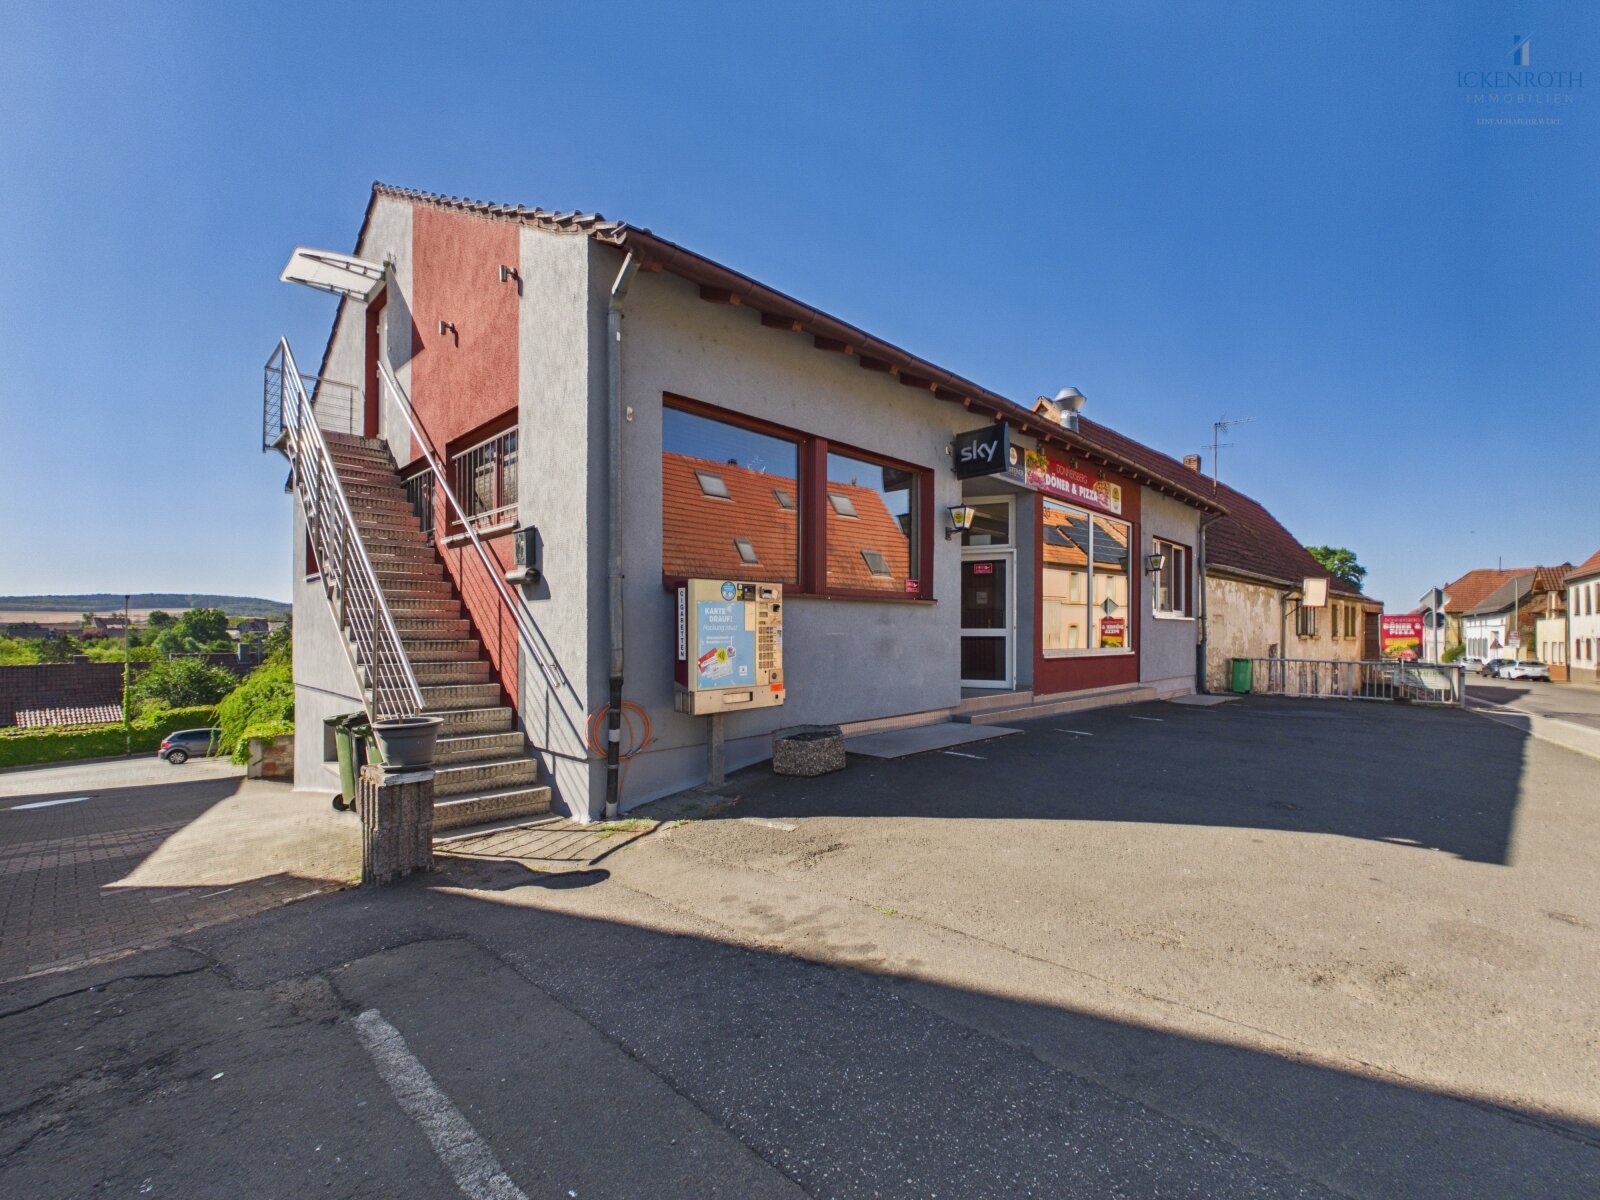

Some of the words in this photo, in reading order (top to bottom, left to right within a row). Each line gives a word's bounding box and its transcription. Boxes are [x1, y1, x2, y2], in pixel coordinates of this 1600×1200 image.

[960, 439, 998, 462] sky
[1045, 472, 1070, 493] DÖNER
[1071, 483, 1077, 495] &
[1079, 485, 1098, 502] PIZZA
[704, 607, 726, 615] KARTE
[709, 615, 733, 623] DRAUF!
[1383, 622, 1412, 630] DÖNER
